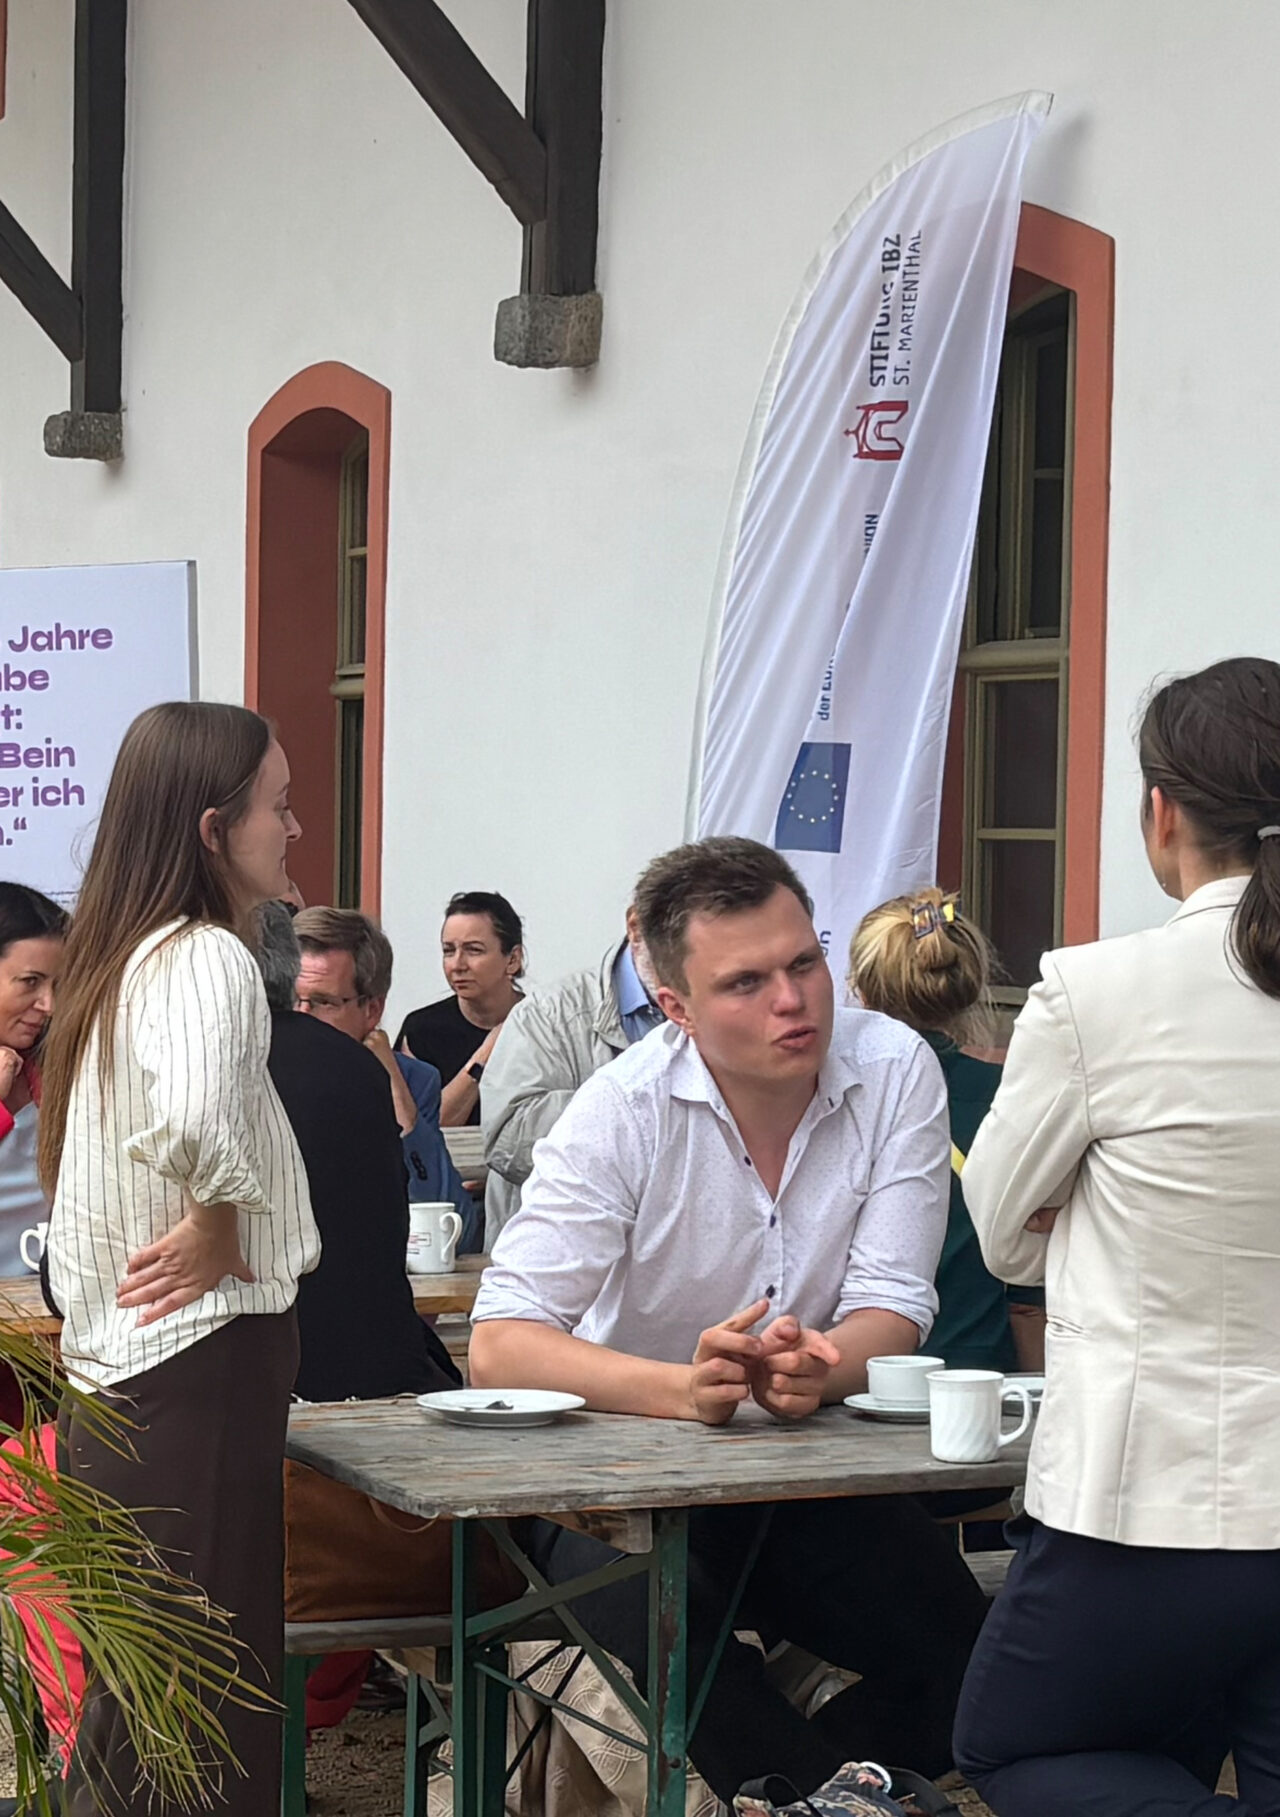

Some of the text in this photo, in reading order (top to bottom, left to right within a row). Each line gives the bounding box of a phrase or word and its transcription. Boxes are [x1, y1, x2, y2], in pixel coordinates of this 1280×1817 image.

[881, 233, 901, 274] IBZ
[893, 229, 922, 385] ST. MARIENTHAL
[8, 622, 113, 652] Jahre
[32, 776, 86, 807] ich
